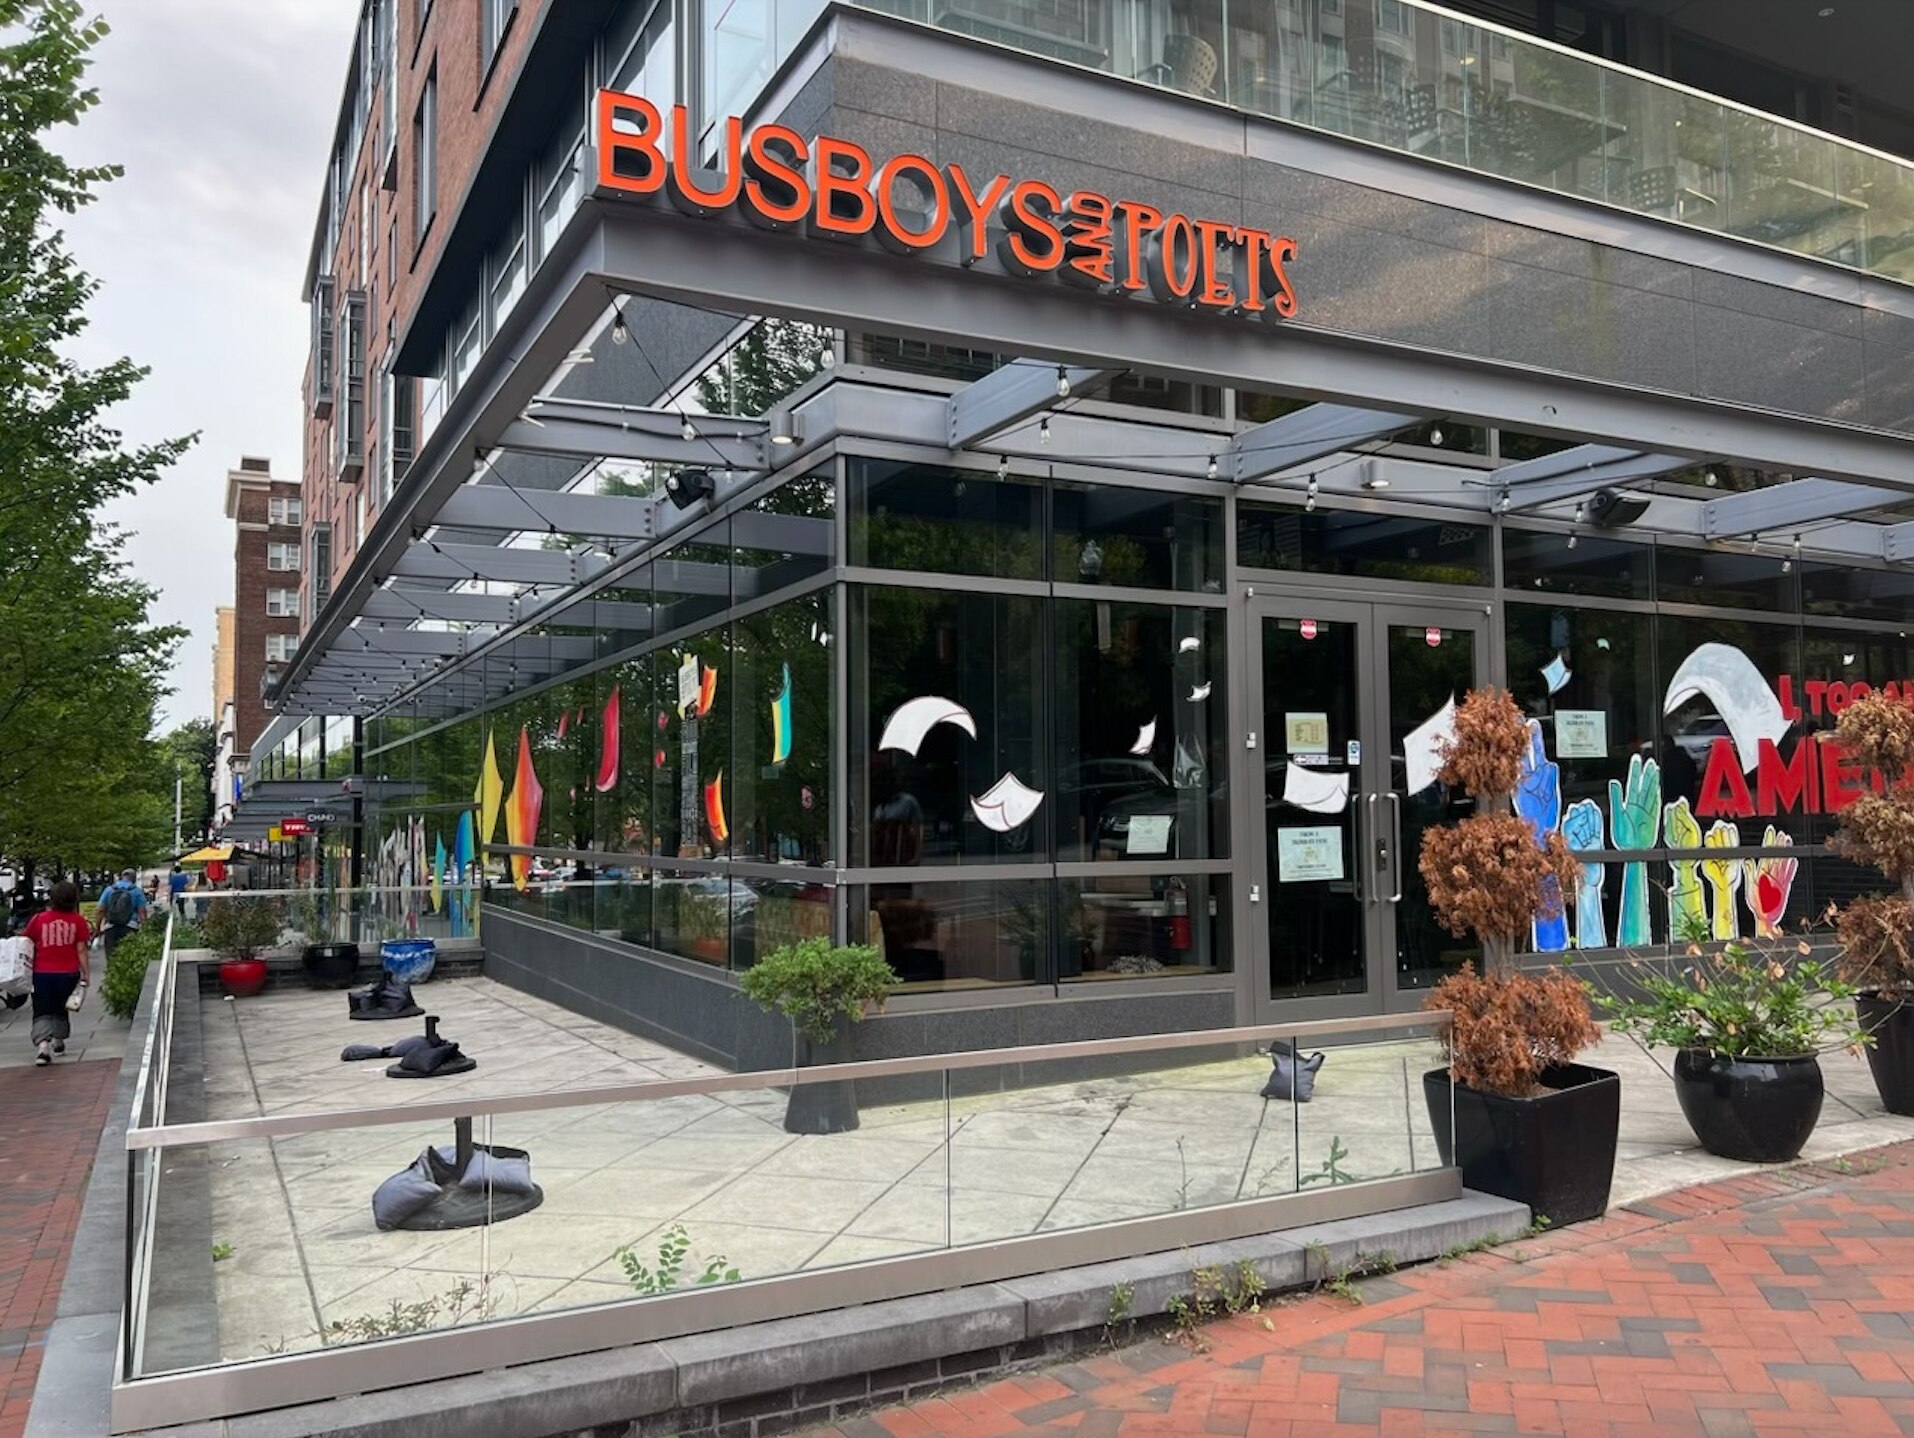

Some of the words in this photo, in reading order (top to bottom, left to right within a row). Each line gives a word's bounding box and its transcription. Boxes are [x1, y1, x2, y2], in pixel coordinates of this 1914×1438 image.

[597, 87, 1065, 271] BUSBOYS
[1070, 191, 1113, 283] AND
[1117, 200, 1298, 318] POETS
